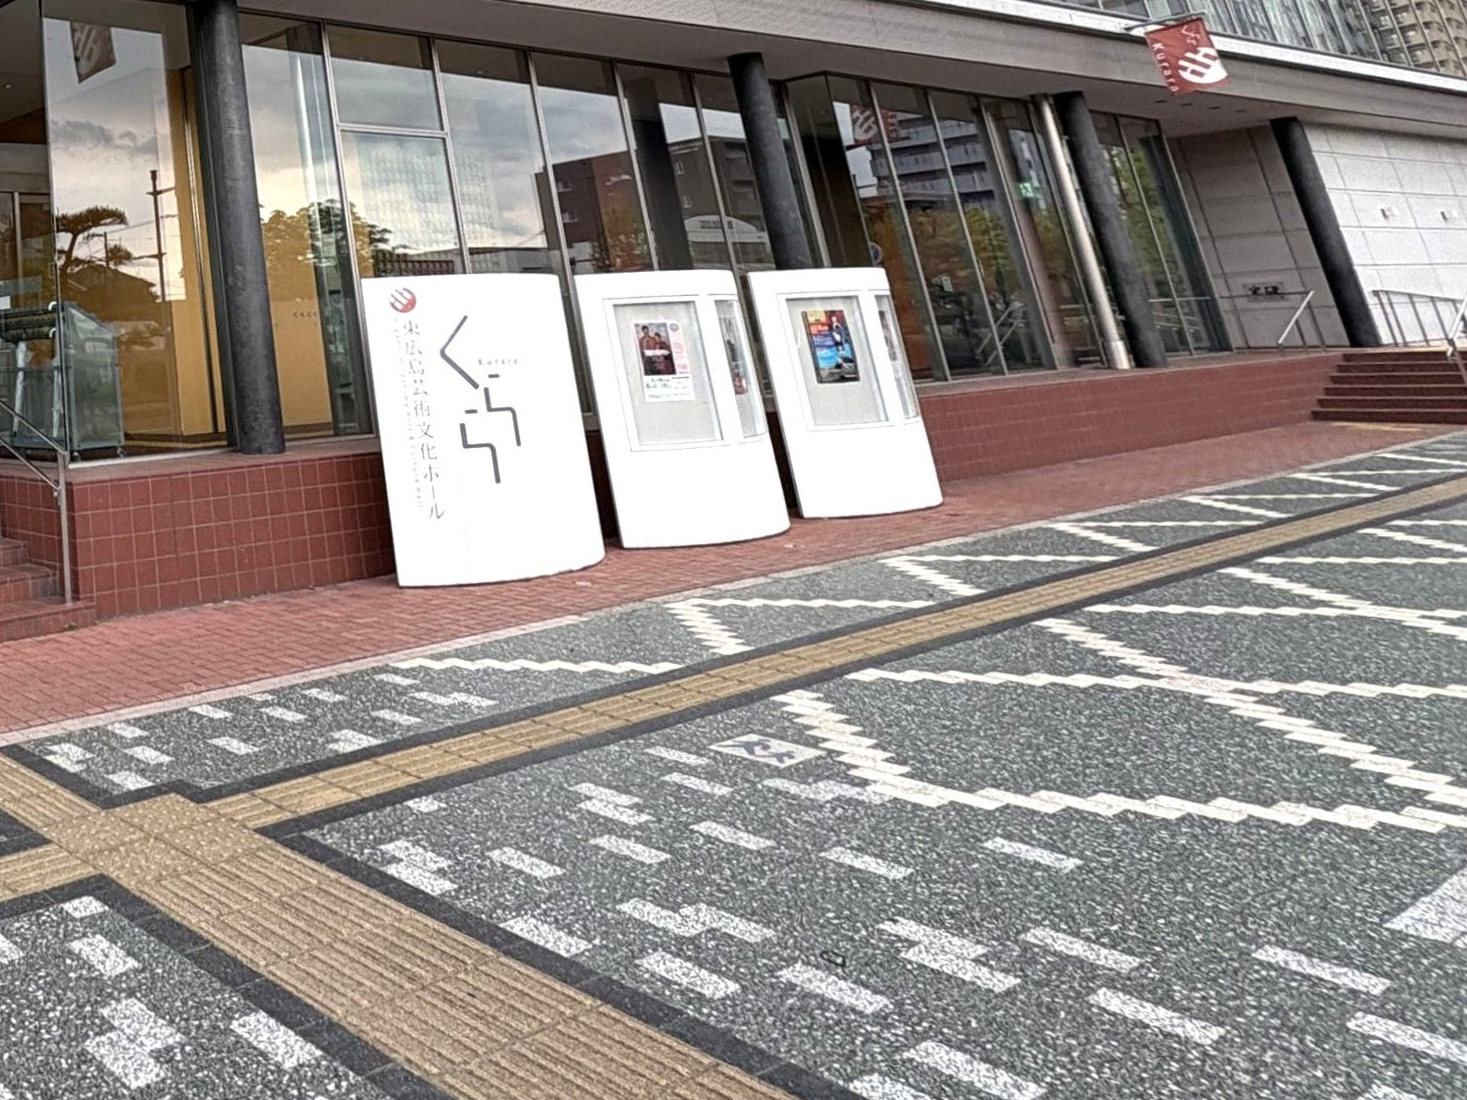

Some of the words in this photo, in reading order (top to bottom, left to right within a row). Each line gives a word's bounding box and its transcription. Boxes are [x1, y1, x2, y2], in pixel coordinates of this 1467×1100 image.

[1151, 42, 1180, 92] Kurara
[477, 357, 519, 367] Kurara
[403, 320, 445, 520] 東広島芸術文化ホール
